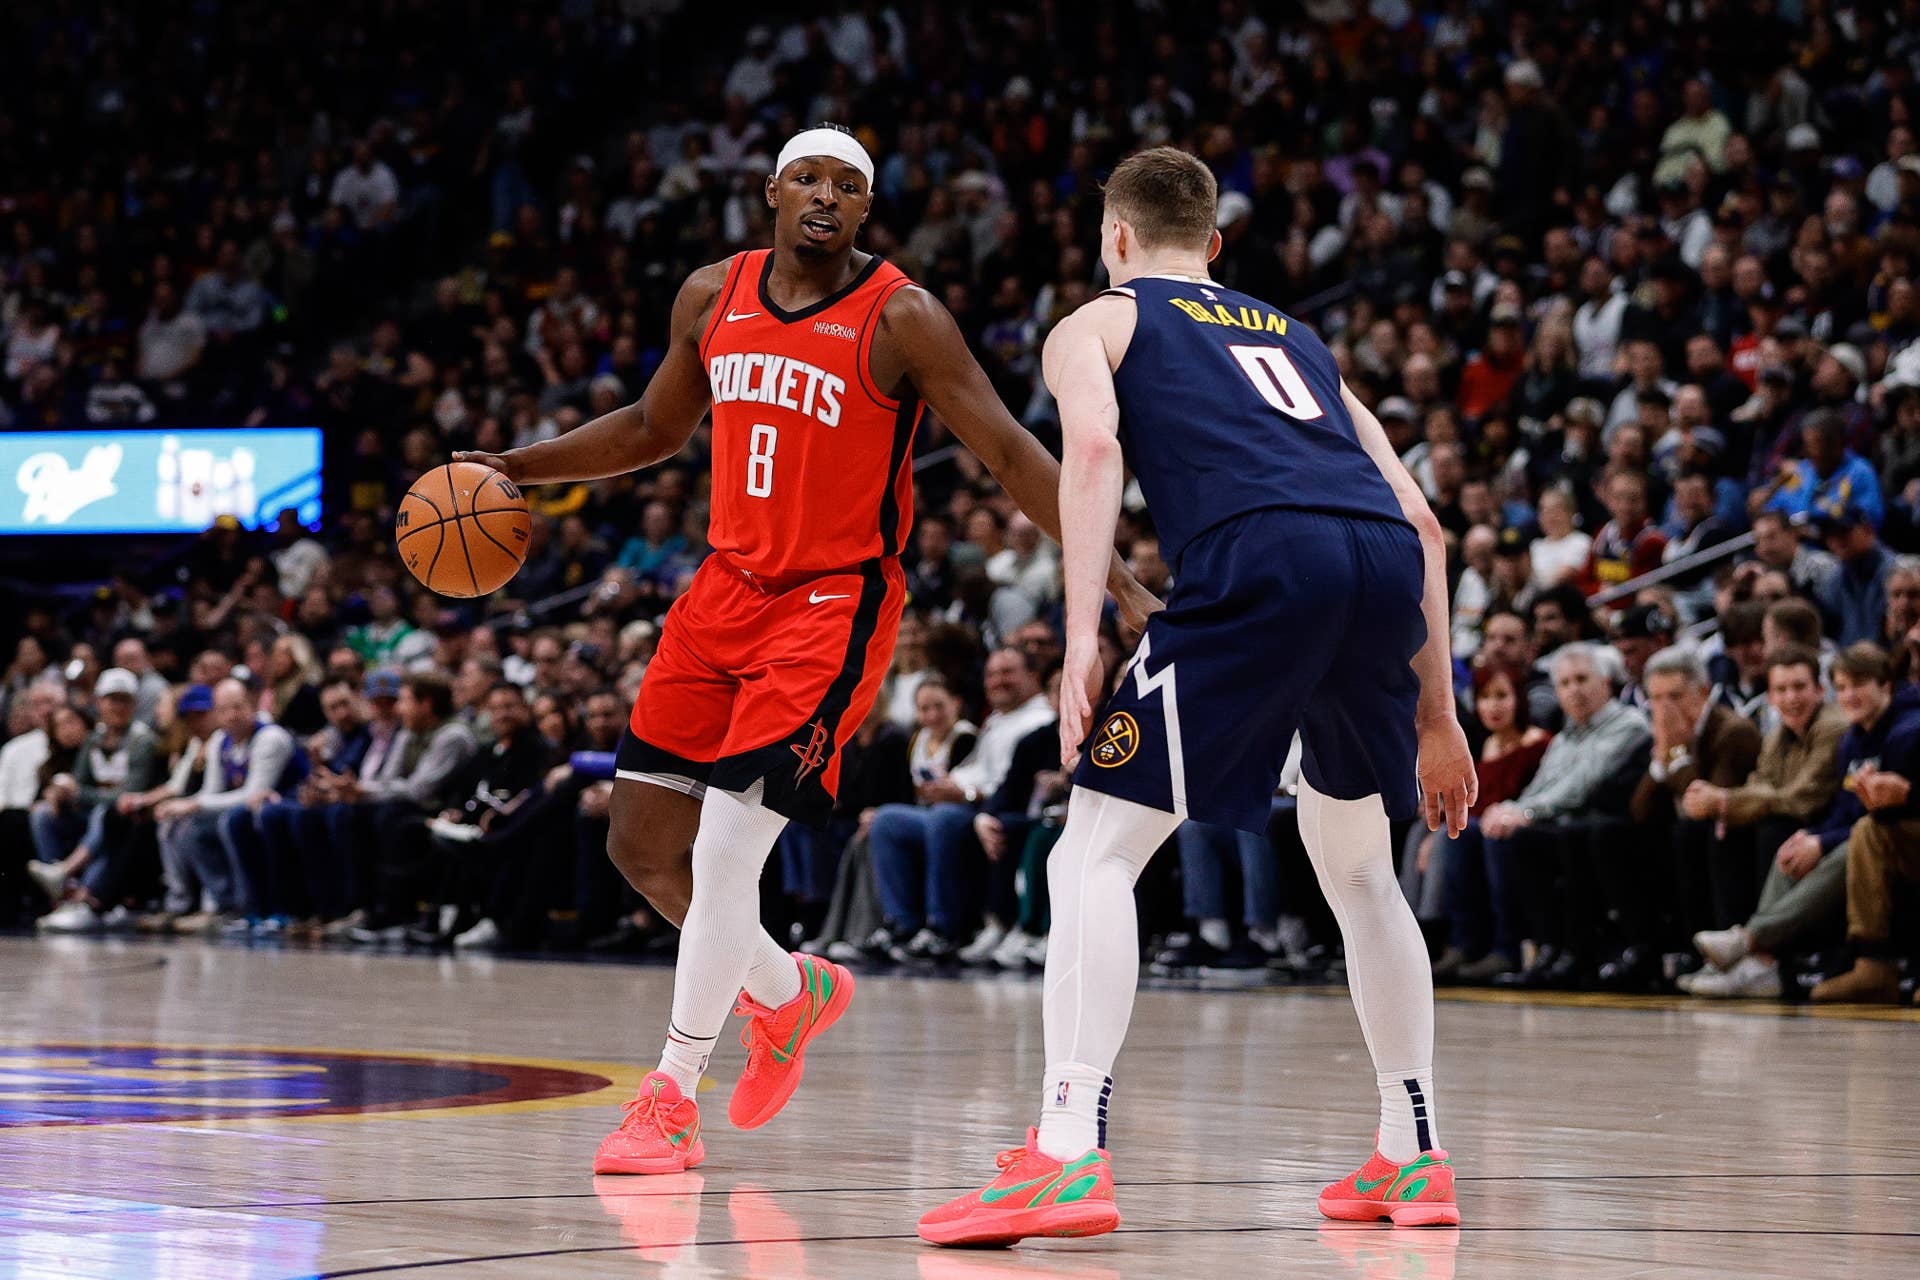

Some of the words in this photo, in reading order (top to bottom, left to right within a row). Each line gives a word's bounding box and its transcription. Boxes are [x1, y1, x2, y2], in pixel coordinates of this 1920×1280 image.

[1168, 297, 1288, 336] BRAUN
[709, 352, 846, 428] ROCKETS
[1225, 344, 1326, 421] 0
[746, 423, 778, 498] 8
